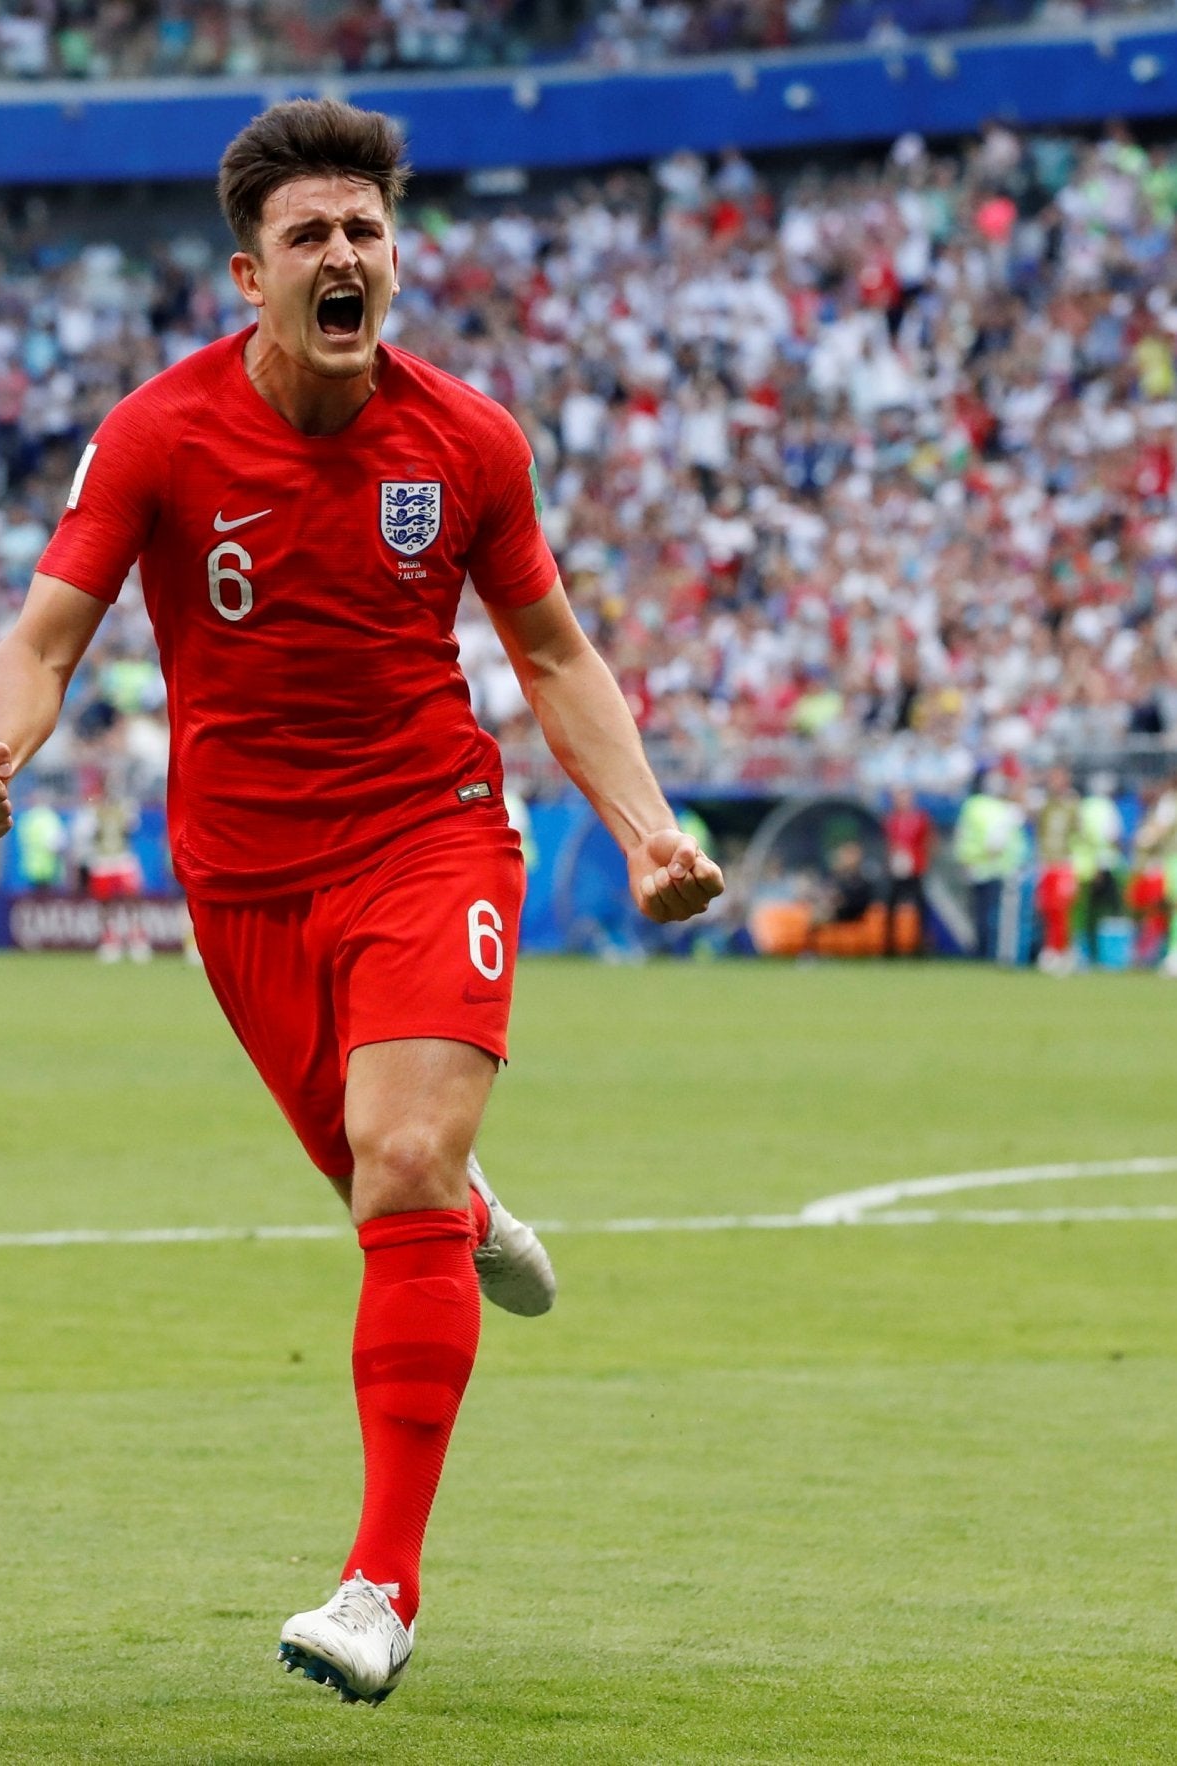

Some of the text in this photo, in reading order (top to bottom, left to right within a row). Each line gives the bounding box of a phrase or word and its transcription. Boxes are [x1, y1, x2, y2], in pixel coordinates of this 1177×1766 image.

[207, 541, 253, 621] 6
[397, 572, 403, 580] 7
[467, 899, 503, 980] 6
